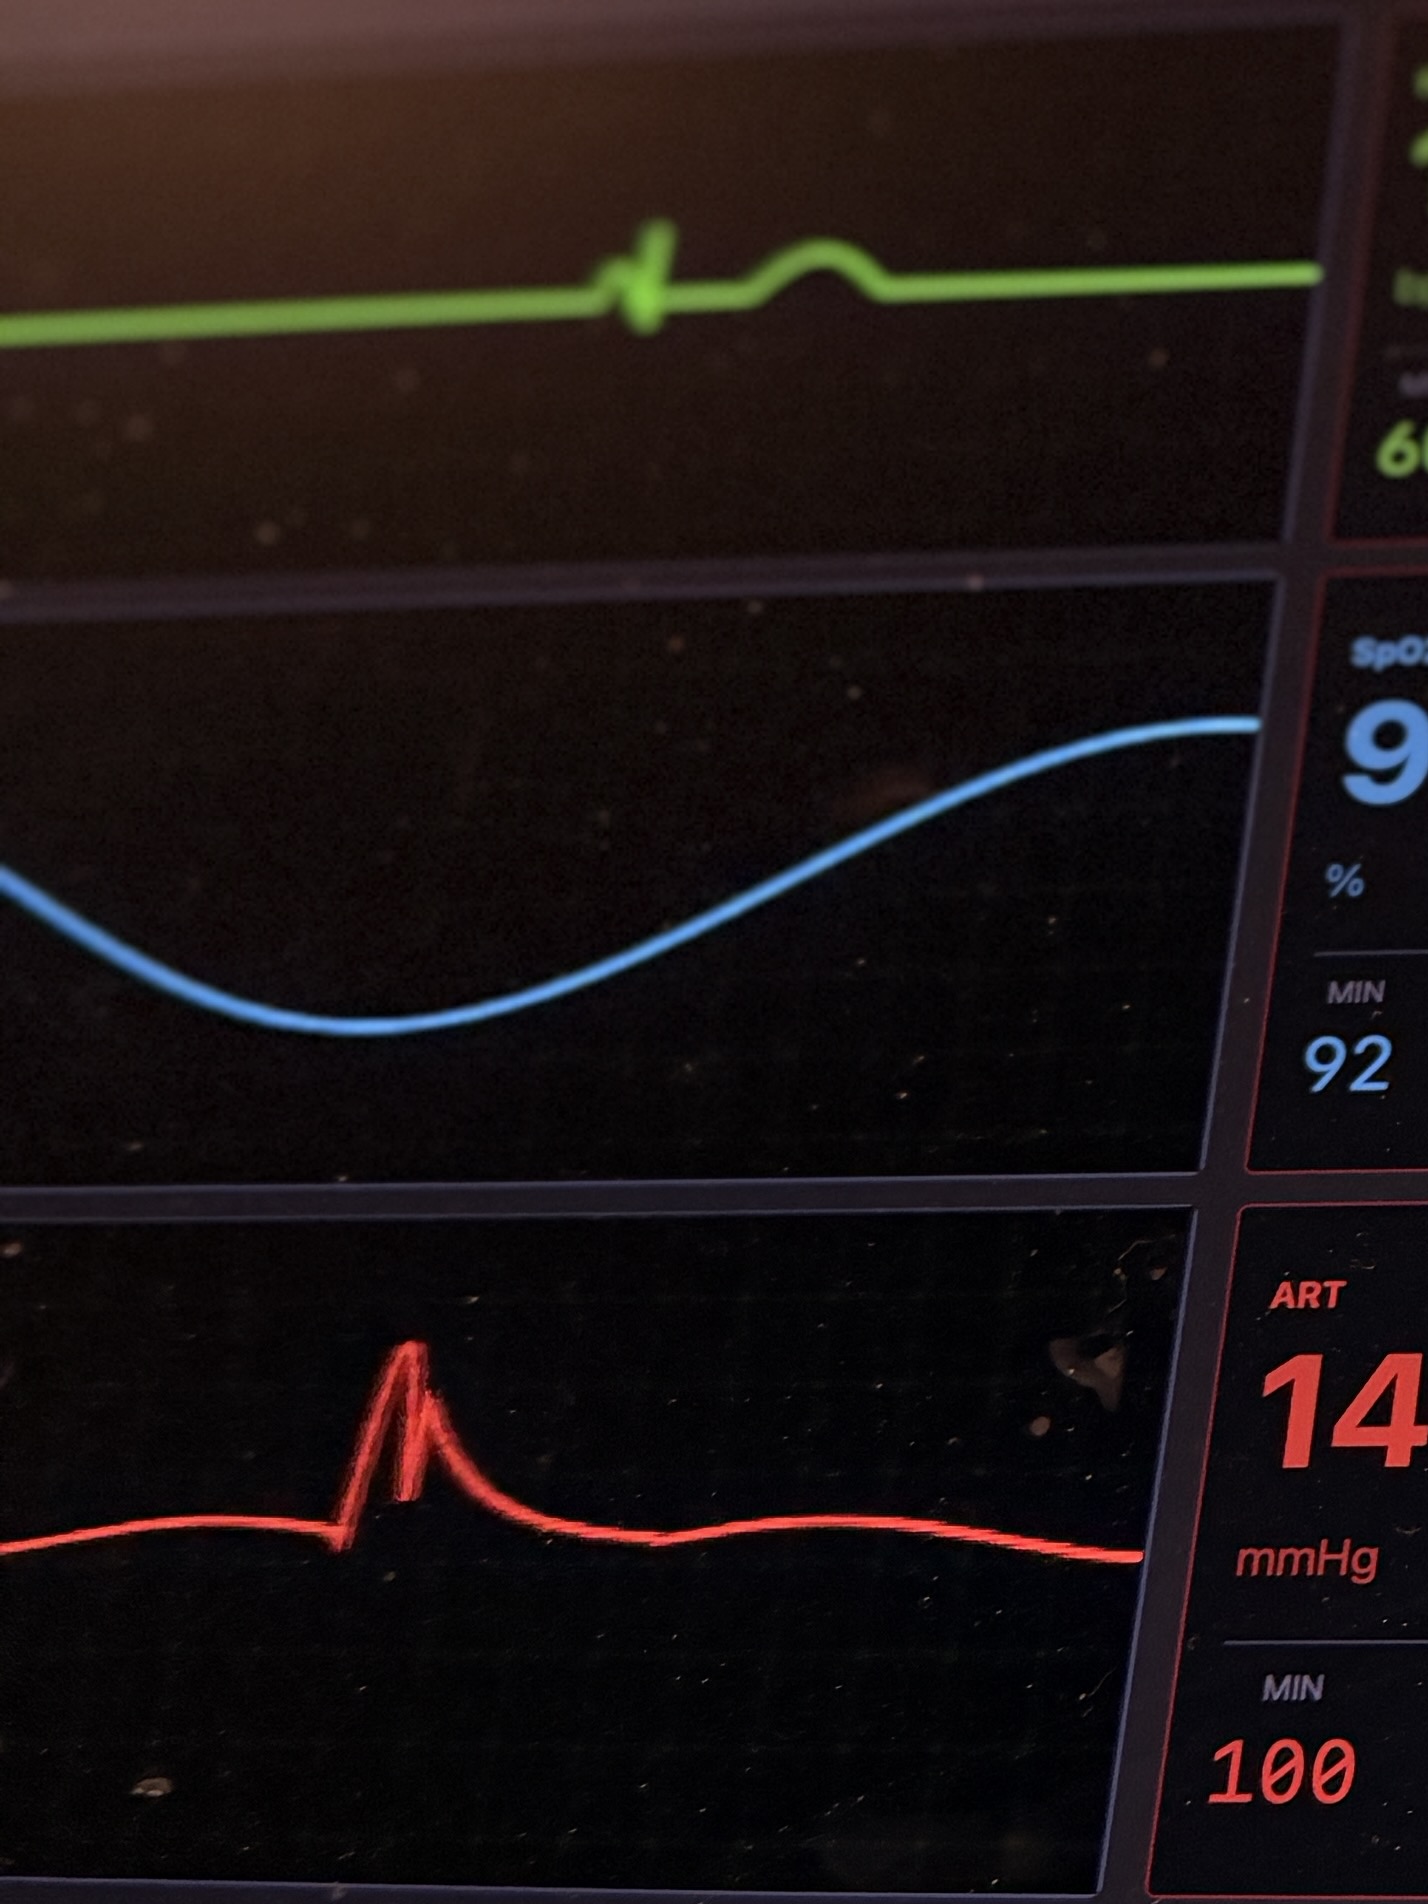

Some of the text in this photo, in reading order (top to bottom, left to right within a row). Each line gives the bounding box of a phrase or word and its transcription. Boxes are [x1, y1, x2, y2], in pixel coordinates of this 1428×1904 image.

[1325, 863, 1365, 898] %
[1327, 979, 1386, 1004] MIN
[1305, 1034, 1392, 1093] 92
[1269, 1280, 1348, 1310] ART
[1235, 1538, 1379, 1585] mmHg
[1262, 1674, 1325, 1702] MIN
[1208, 1738, 1356, 1805] 100
